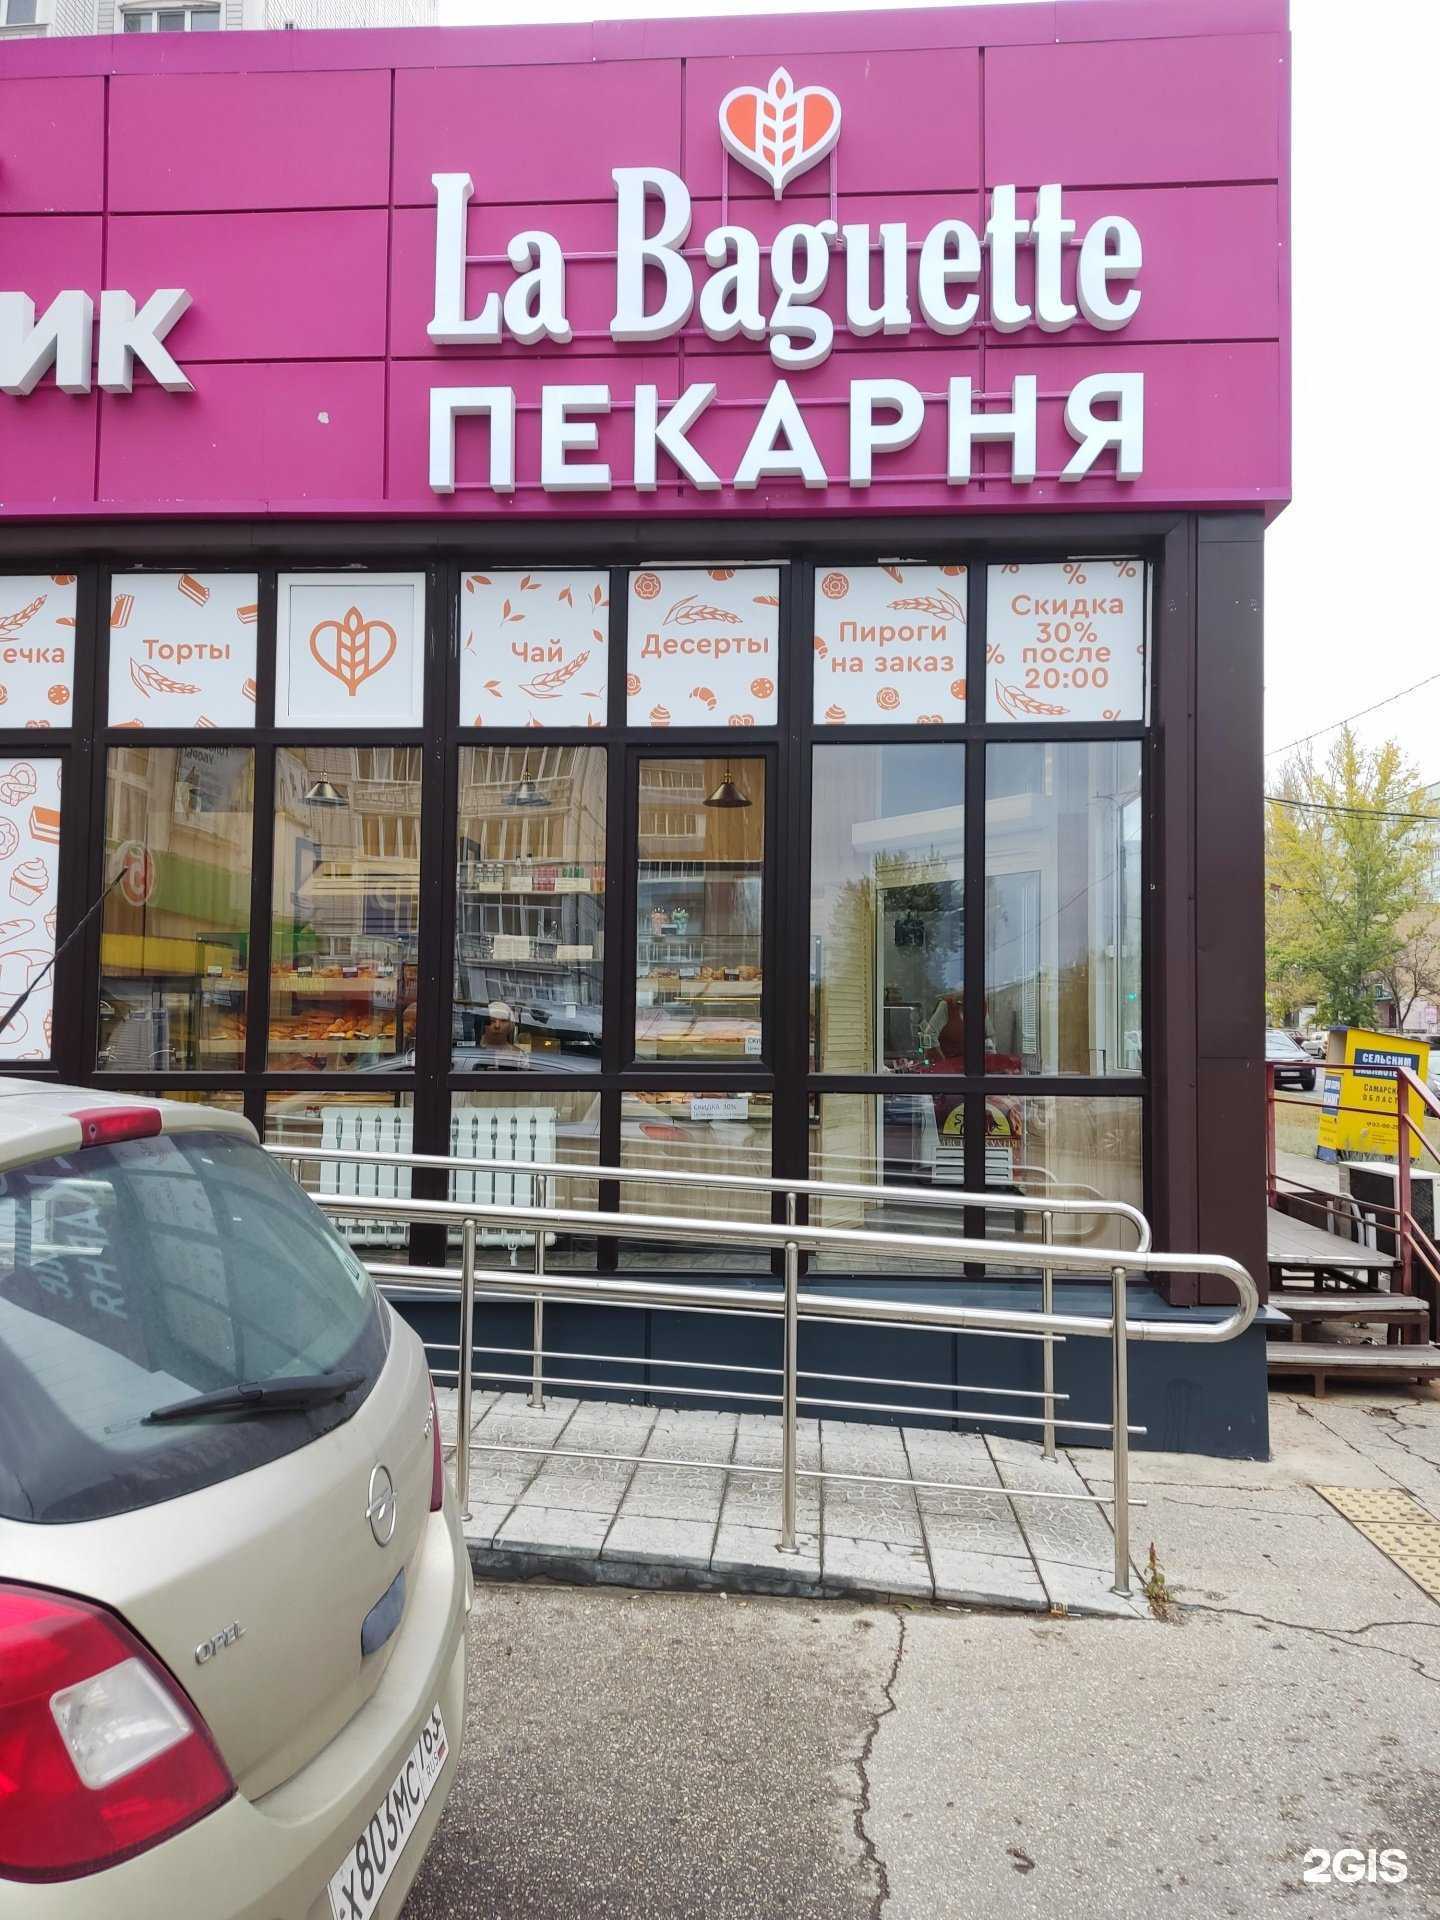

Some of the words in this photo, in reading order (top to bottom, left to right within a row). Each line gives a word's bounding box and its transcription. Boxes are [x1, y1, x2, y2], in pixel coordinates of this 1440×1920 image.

[427, 172, 572, 345] La
[610, 166, 1143, 370] Baguette
[429, 372, 1144, 494] ПЕКАРНЯ
[1010, 593, 1125, 617] Скидка
[838, 620, 948, 645] Пироги
[1035, 621, 1098, 644] 30%
[2, 647, 66, 664] ечка
[142, 637, 231, 664] Торты
[511, 637, 564, 664] Чай
[640, 632, 770, 660] Десерты
[1021, 645, 1112, 664] после
[831, 656, 868, 674] на
[874, 653, 955, 674] заказ
[1025, 667, 1110, 689] 20:00
